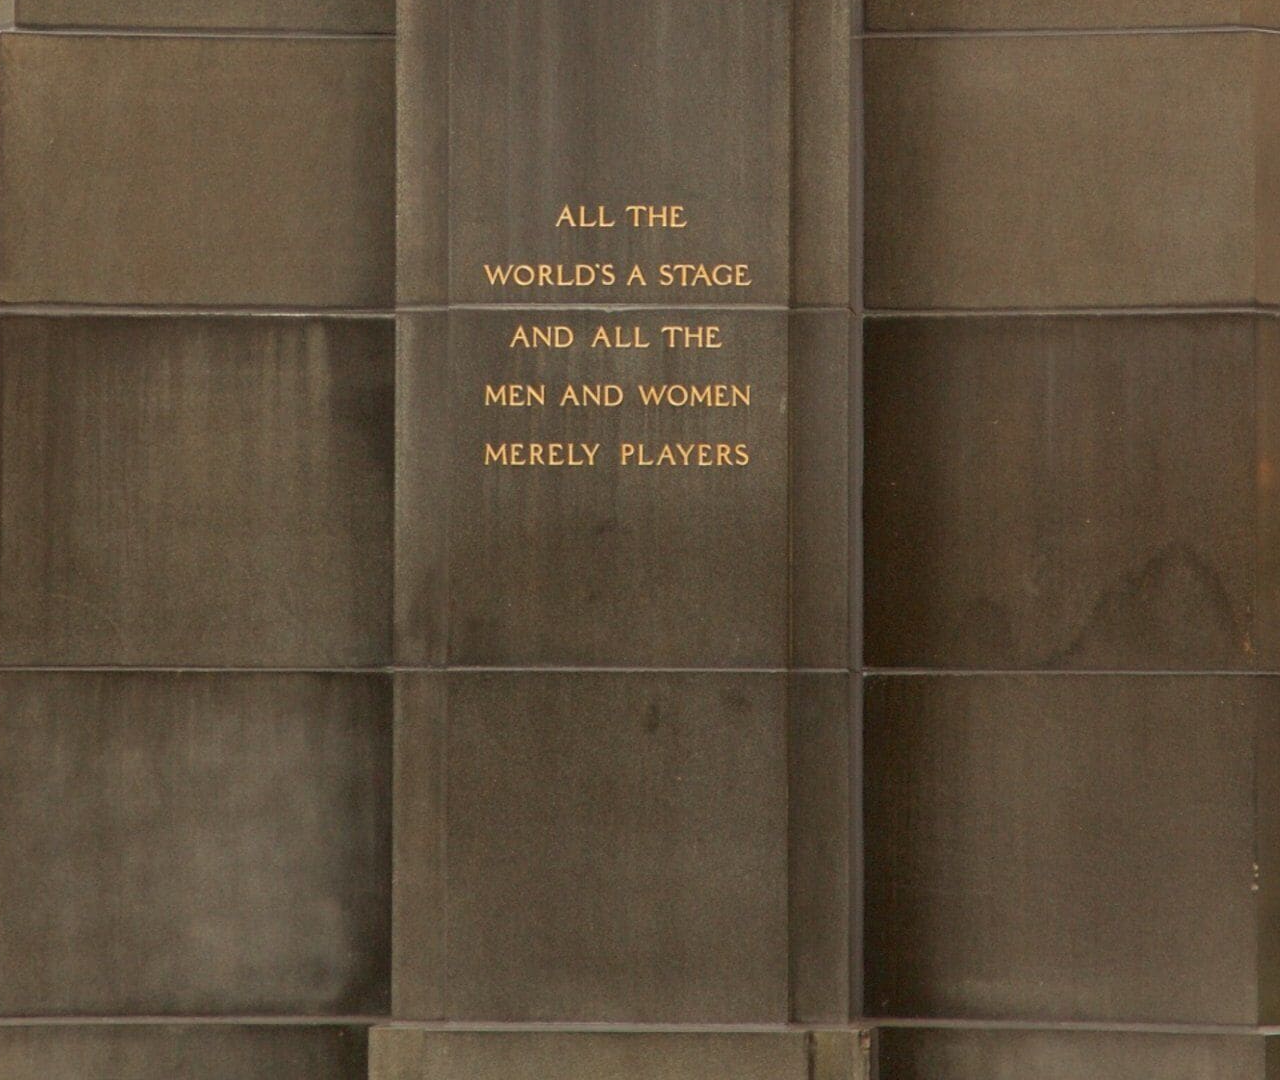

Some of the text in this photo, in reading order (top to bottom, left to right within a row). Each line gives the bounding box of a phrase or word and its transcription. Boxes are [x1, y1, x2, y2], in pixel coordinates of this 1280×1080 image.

[556, 204, 687, 228] ALL THE
[484, 263, 753, 287] WORLD'S A STAGE
[510, 326, 723, 349] AND ALL THE
[484, 384, 752, 407] MEN AND WOMEN
[484, 442, 750, 466] MERELY PLAYERS
